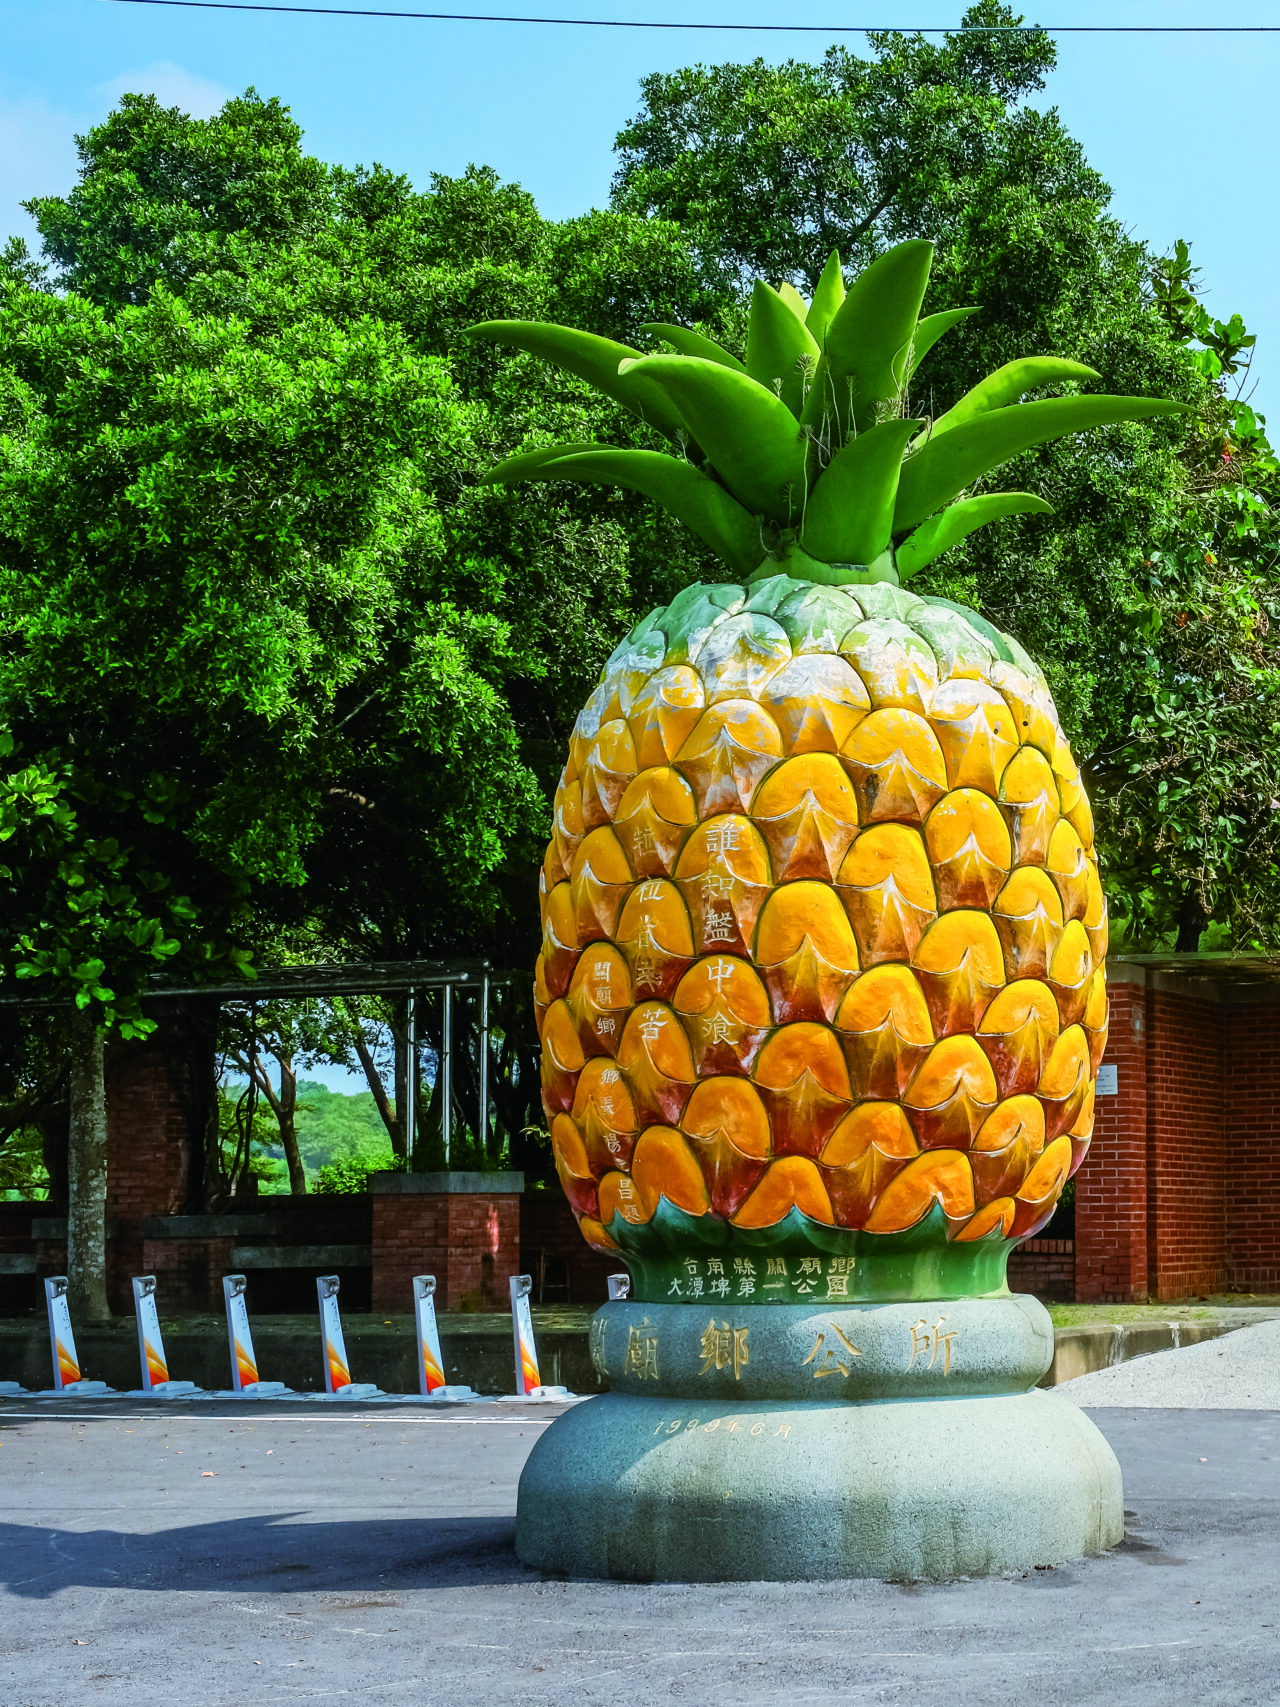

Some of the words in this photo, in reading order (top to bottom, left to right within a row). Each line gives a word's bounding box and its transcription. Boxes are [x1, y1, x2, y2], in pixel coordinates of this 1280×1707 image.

[667, 1275, 849, 1299] 大潭埤第一公園
